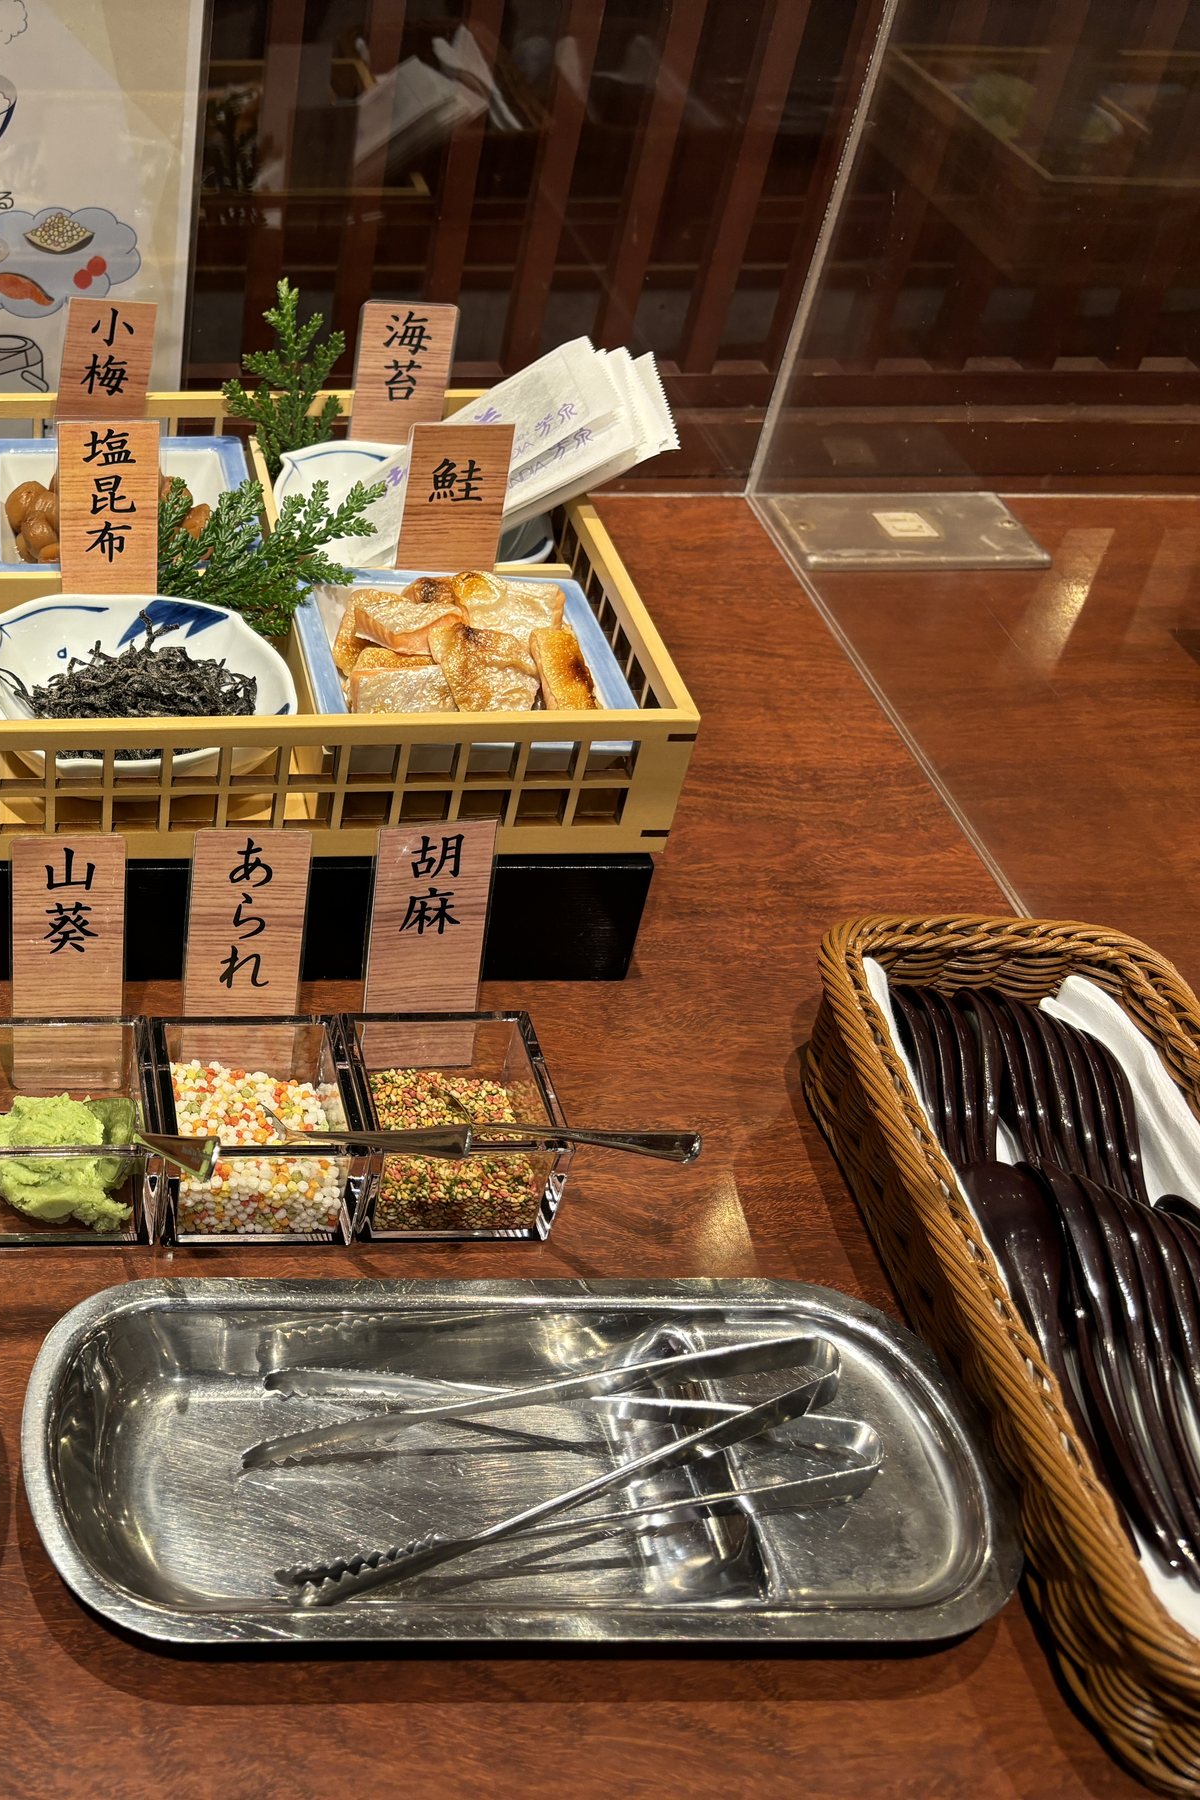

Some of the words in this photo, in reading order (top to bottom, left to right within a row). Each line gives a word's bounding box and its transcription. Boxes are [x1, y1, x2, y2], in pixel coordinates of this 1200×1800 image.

[80, 306, 135, 397] 小梅
[383, 310, 433, 401] 海苔
[82, 430, 137, 563] 塩昆布
[428, 457, 484, 503] 鮭
[43, 847, 99, 955] 山葵
[218, 837, 273, 989] あられ
[398, 833, 465, 935] 胡麻
